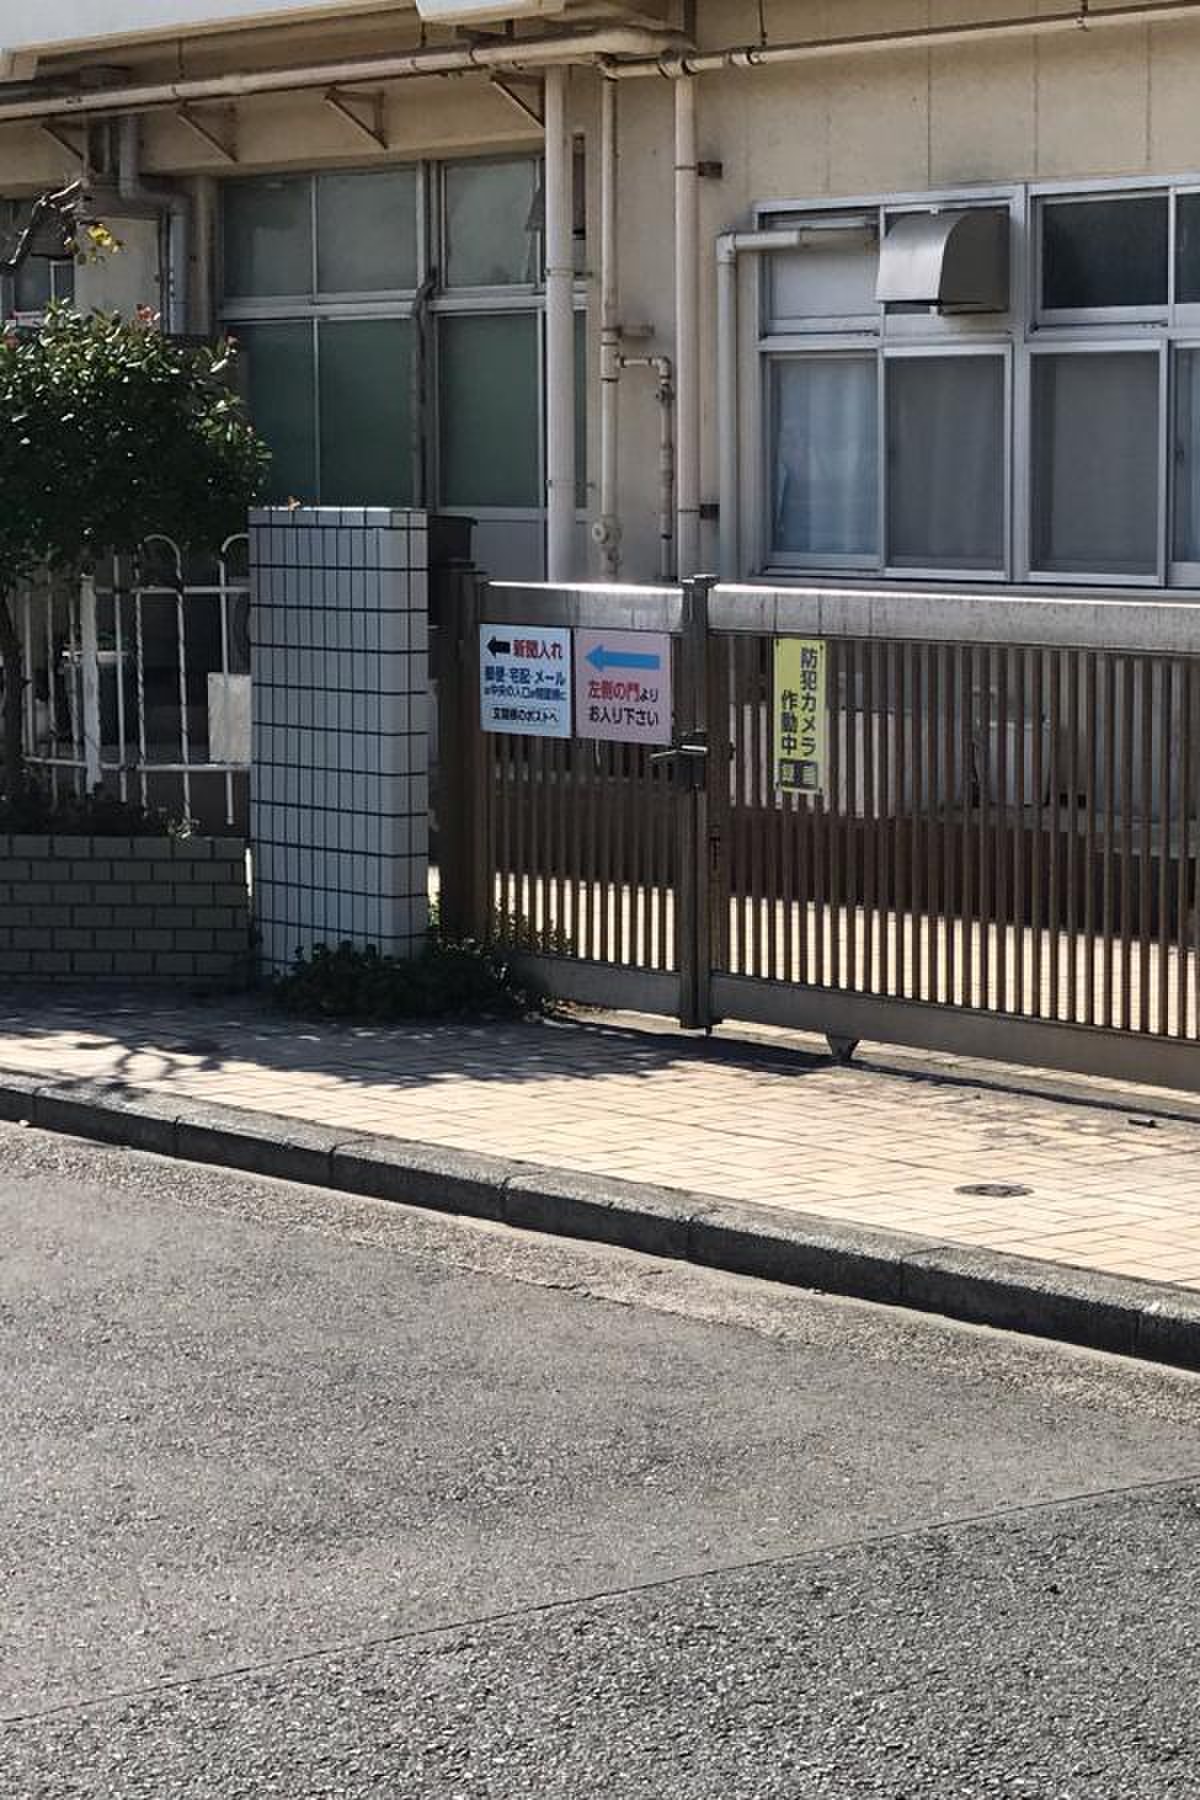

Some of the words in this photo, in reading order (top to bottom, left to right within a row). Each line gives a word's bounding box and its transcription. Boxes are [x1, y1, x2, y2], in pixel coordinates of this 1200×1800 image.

[513, 639, 563, 660] 新聞入れ
[588, 679, 659, 703] 左側の門より
[800, 647, 818, 757] 防犯カメラ
[588, 705, 659, 727] お入り下さい
[780, 688, 798, 756] 作動中
